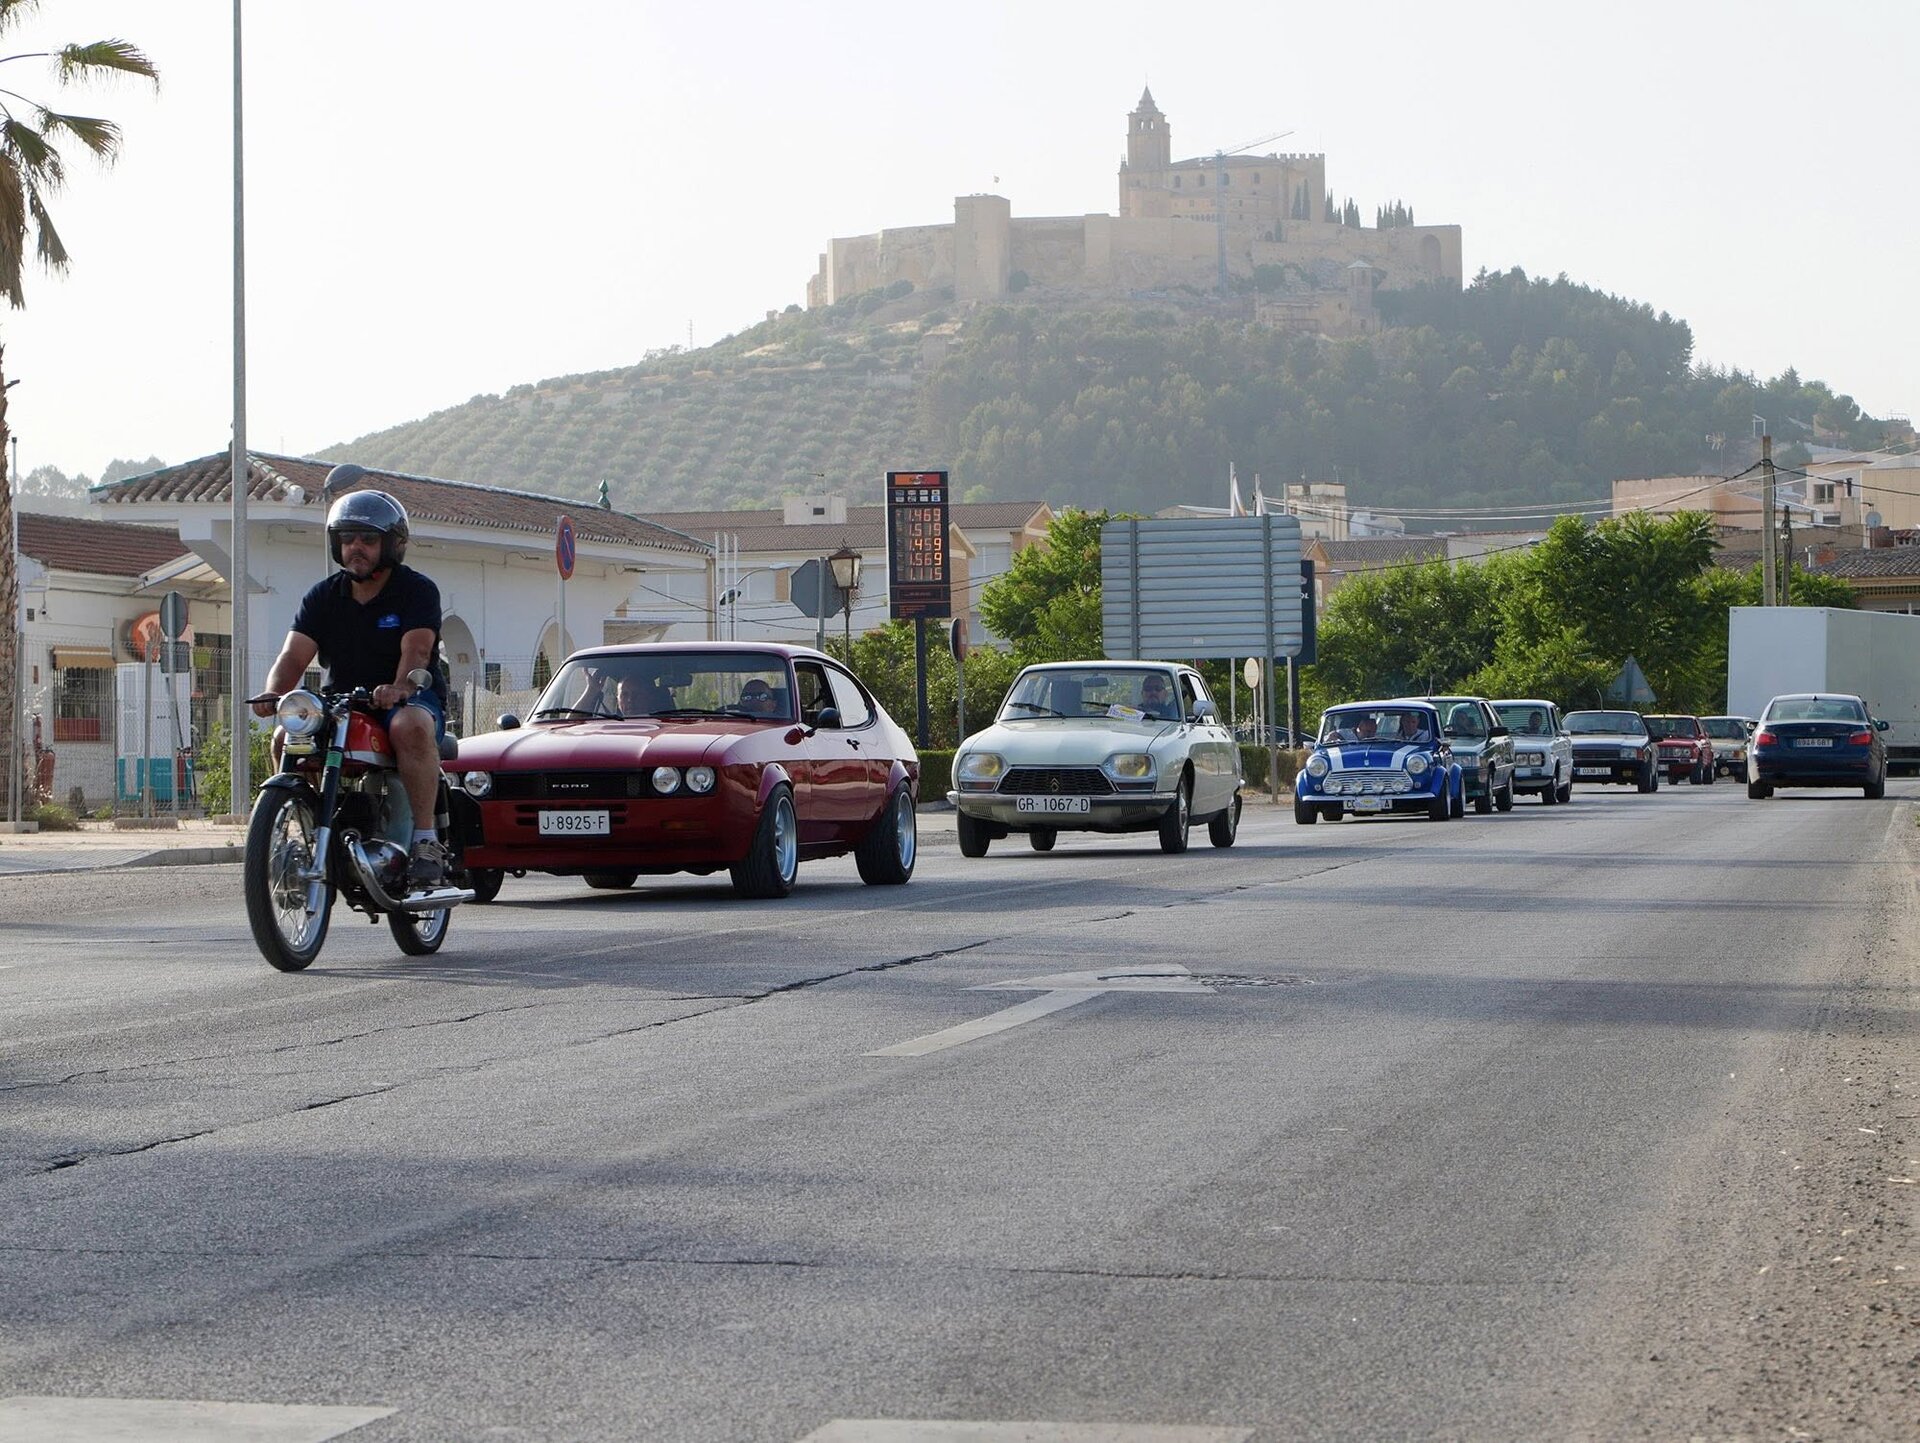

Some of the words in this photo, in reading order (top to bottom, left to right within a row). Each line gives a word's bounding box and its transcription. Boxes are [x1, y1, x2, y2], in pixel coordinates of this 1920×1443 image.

[909, 508, 941, 522] 1.469
[909, 523, 941, 537] 1.519
[909, 537, 942, 551] 1.459
[909, 552, 942, 566] 1.569
